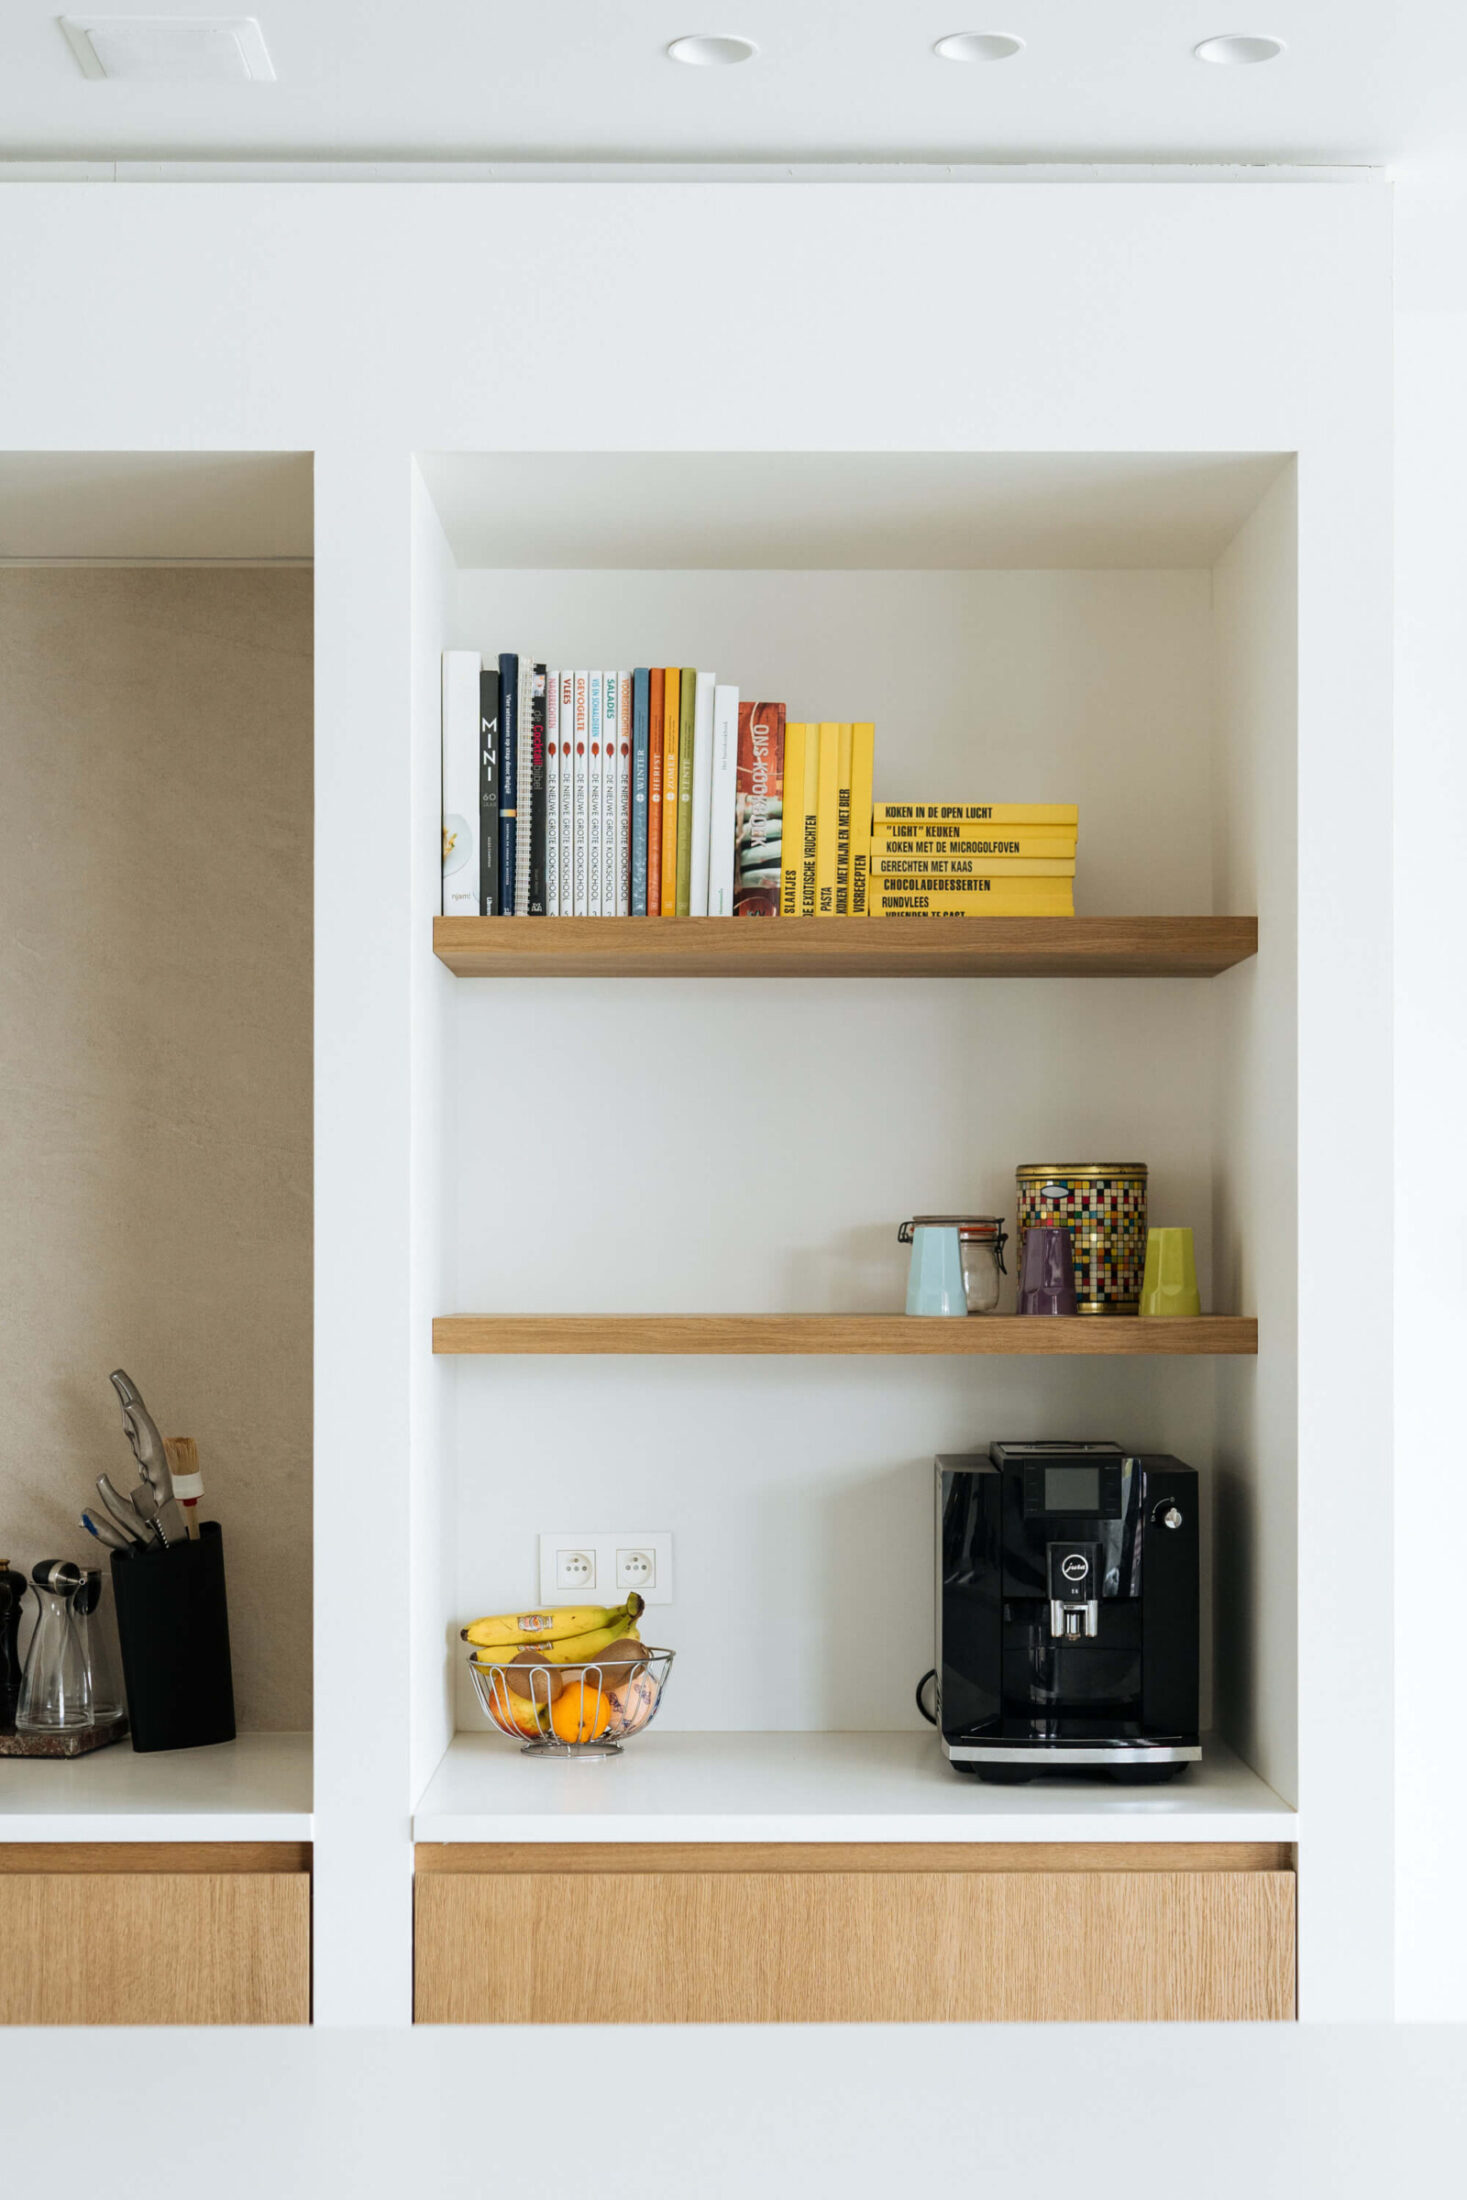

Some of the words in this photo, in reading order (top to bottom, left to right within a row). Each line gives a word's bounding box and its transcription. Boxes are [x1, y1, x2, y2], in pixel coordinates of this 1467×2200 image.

[563, 679, 571, 704] VLEES
[592, 679, 600, 687] VIS
[577, 678, 585, 731] GEVOGELTE
[607, 679, 615, 719] SALADES
[534, 710, 543, 722] de
[482, 717, 497, 781] MINI
[504, 738, 512, 746] op
[753, 724, 769, 757] ONS
[504, 747, 512, 760] stap
[533, 725, 544, 790] Cocktailbijbel
[549, 774, 556, 783] DE
[563, 774, 570, 783] DE
[577, 774, 584, 783] DE
[592, 774, 599, 783] DE
[621, 774, 628, 784] DE
[637, 750, 645, 790] WINTER
[653, 754, 661, 791] HERFST
[667, 754, 675, 789] ZOMER
[683, 759, 691, 790] LENTE
[504, 776, 512, 794] België
[606, 775, 613, 784] DE
[482, 793, 497, 801] 60
[751, 762, 768, 848] KOOKBOEK
[839, 789, 850, 807] BIER
[839, 809, 850, 826] MET
[885, 806, 913, 818] KOKEN
[916, 807, 924, 818] IN
[928, 807, 938, 818] DE
[941, 807, 963, 819] OPEN
[965, 807, 992, 819] LUCHT
[804, 815, 816, 858] VRUCHTEN
[838, 829, 849, 840] EN
[926, 826, 960, 837] KEUKEN
[838, 842, 849, 865] WIJN
[886, 841, 913, 853] KOKEN
[916, 842, 933, 853] MET
[936, 842, 946, 853] DE
[950, 842, 1020, 853] MICROGOLFOVEN
[881, 860, 928, 872] GERECHTEN
[931, 861, 948, 872] MET
[951, 861, 973, 872] KAAS
[803, 861, 815, 906] EXOTISCHE
[837, 867, 848, 885] MET
[854, 855, 866, 912] VISRECEPTEN
[884, 879, 990, 891] CHOCOLADEDESSERTEN
[784, 870, 797, 914] SLAATJES
[820, 887, 832, 911] PASTA
[836, 887, 848, 914] KOKEN
[882, 896, 929, 908] RUNDVLEES
[1065, 1562, 1085, 1573] jura
